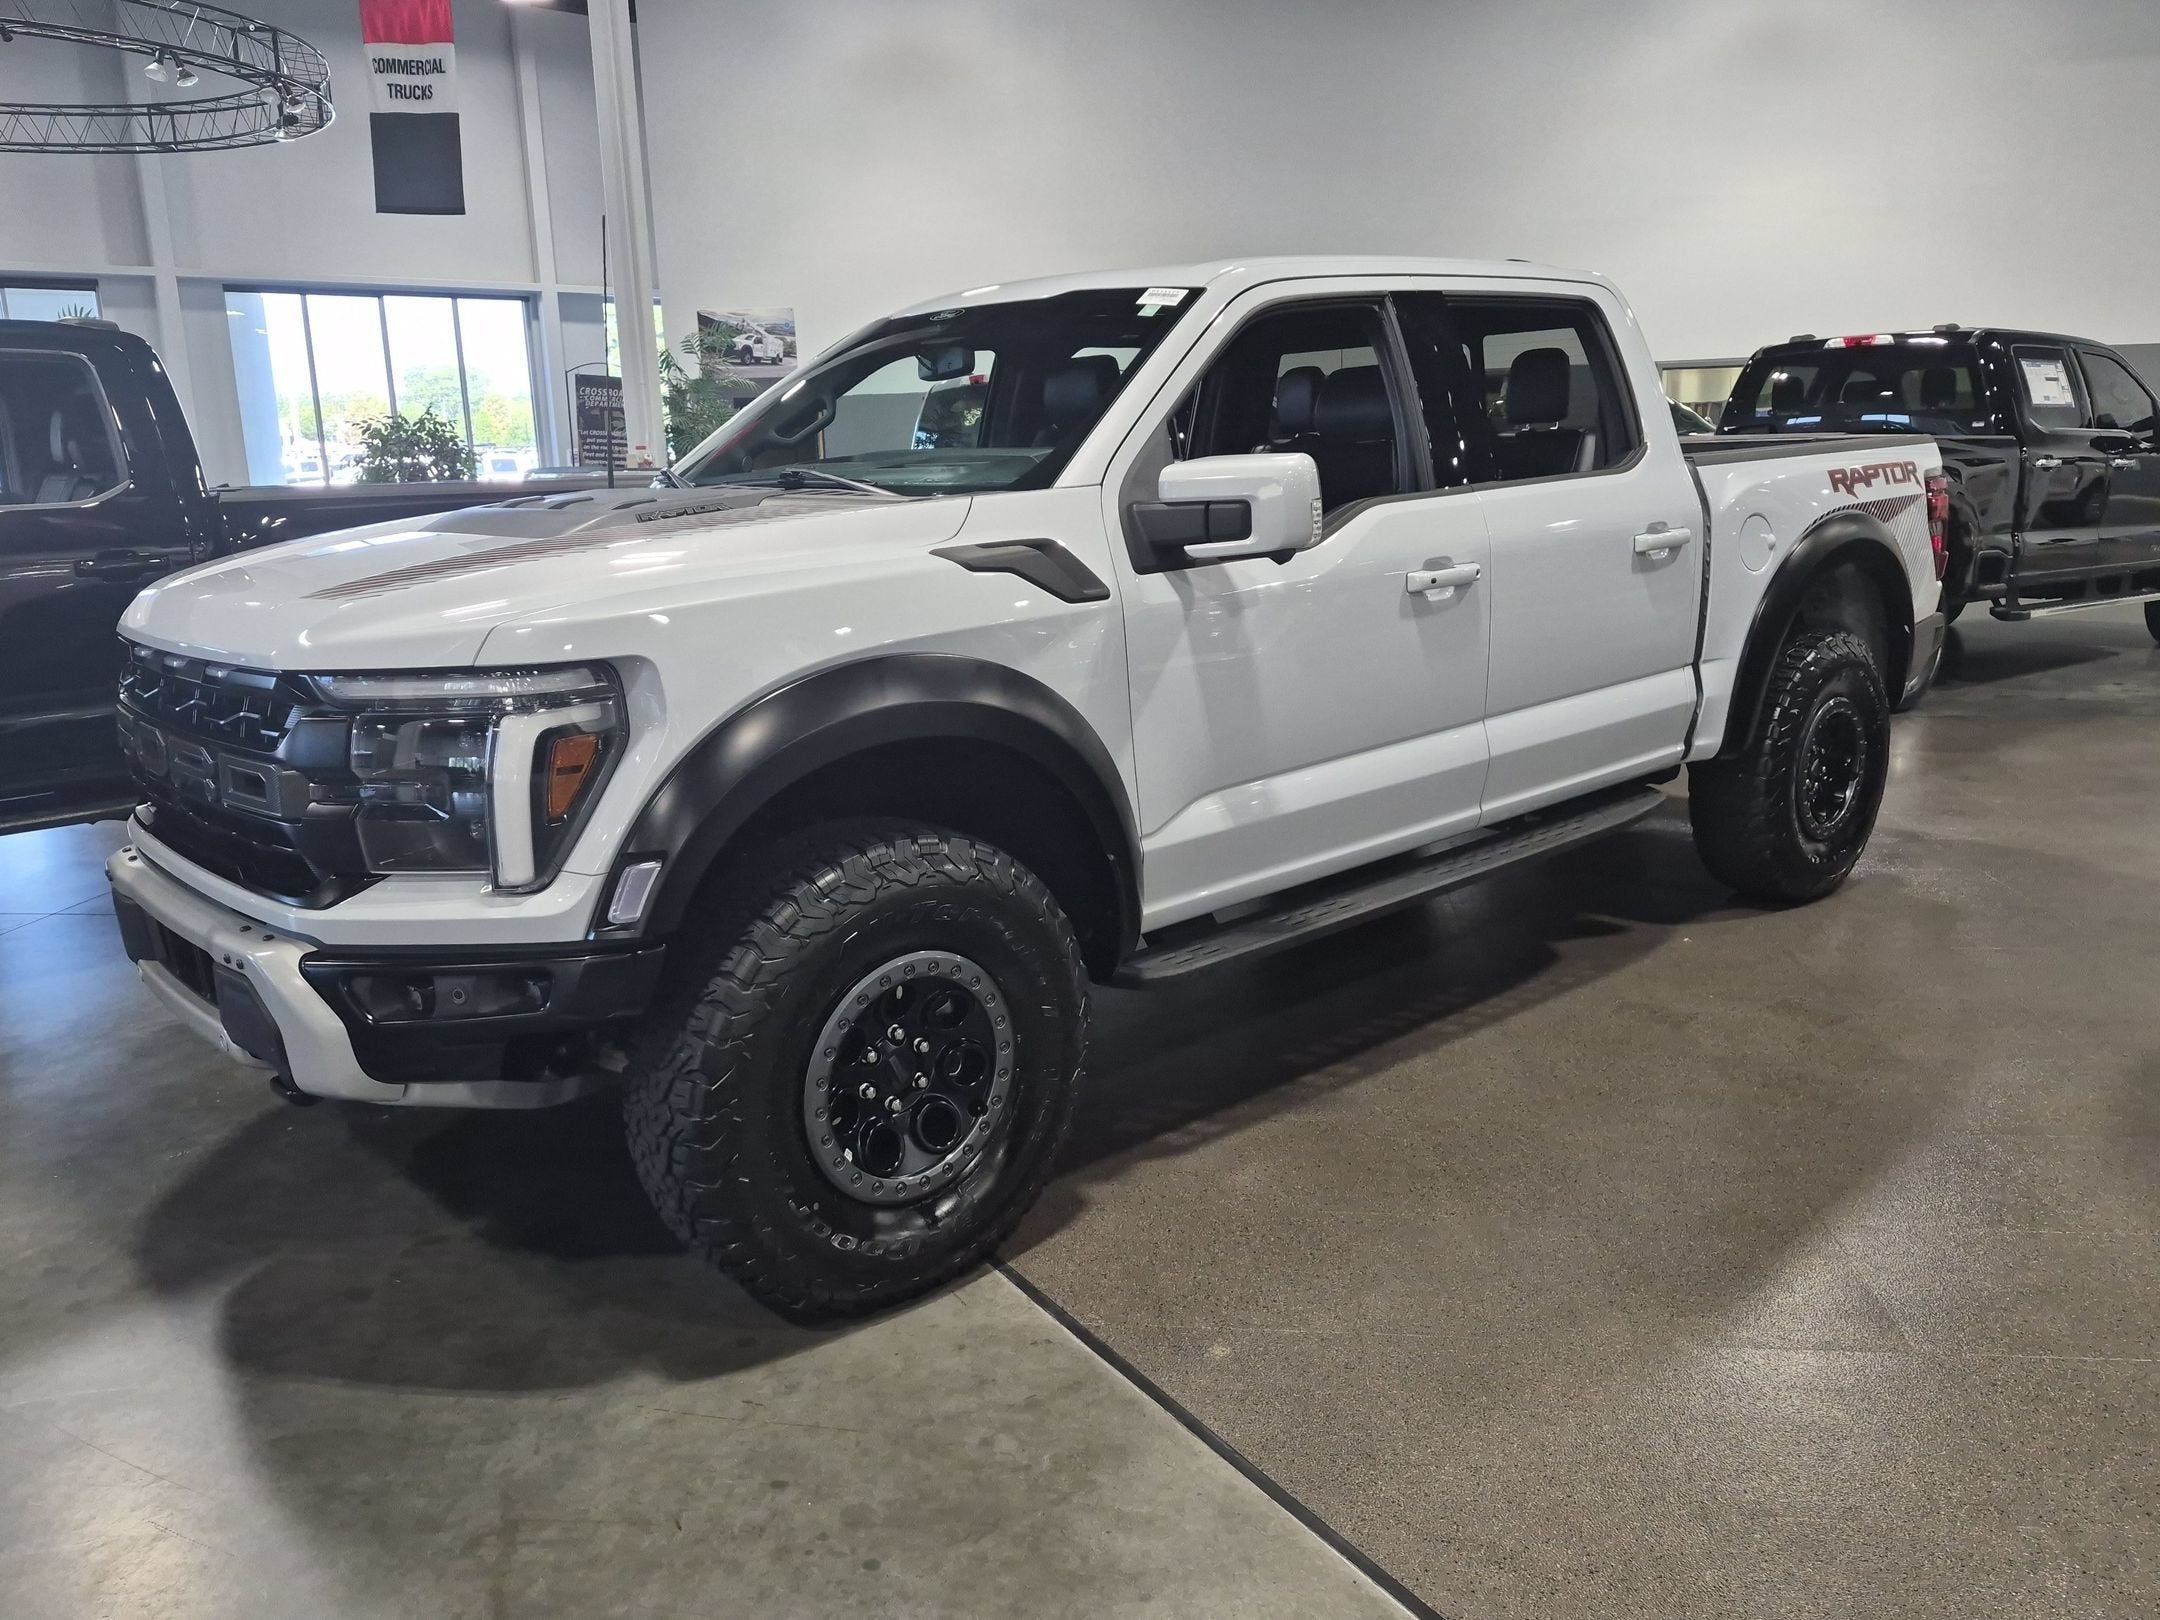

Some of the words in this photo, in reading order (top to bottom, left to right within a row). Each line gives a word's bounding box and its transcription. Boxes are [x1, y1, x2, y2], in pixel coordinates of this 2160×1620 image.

[372, 58, 446, 75] COMMERCIAL
[387, 83, 433, 100] TRUCKS
[579, 387, 623, 397] CROSSROA
[1827, 461, 1923, 499] RAPTOR
